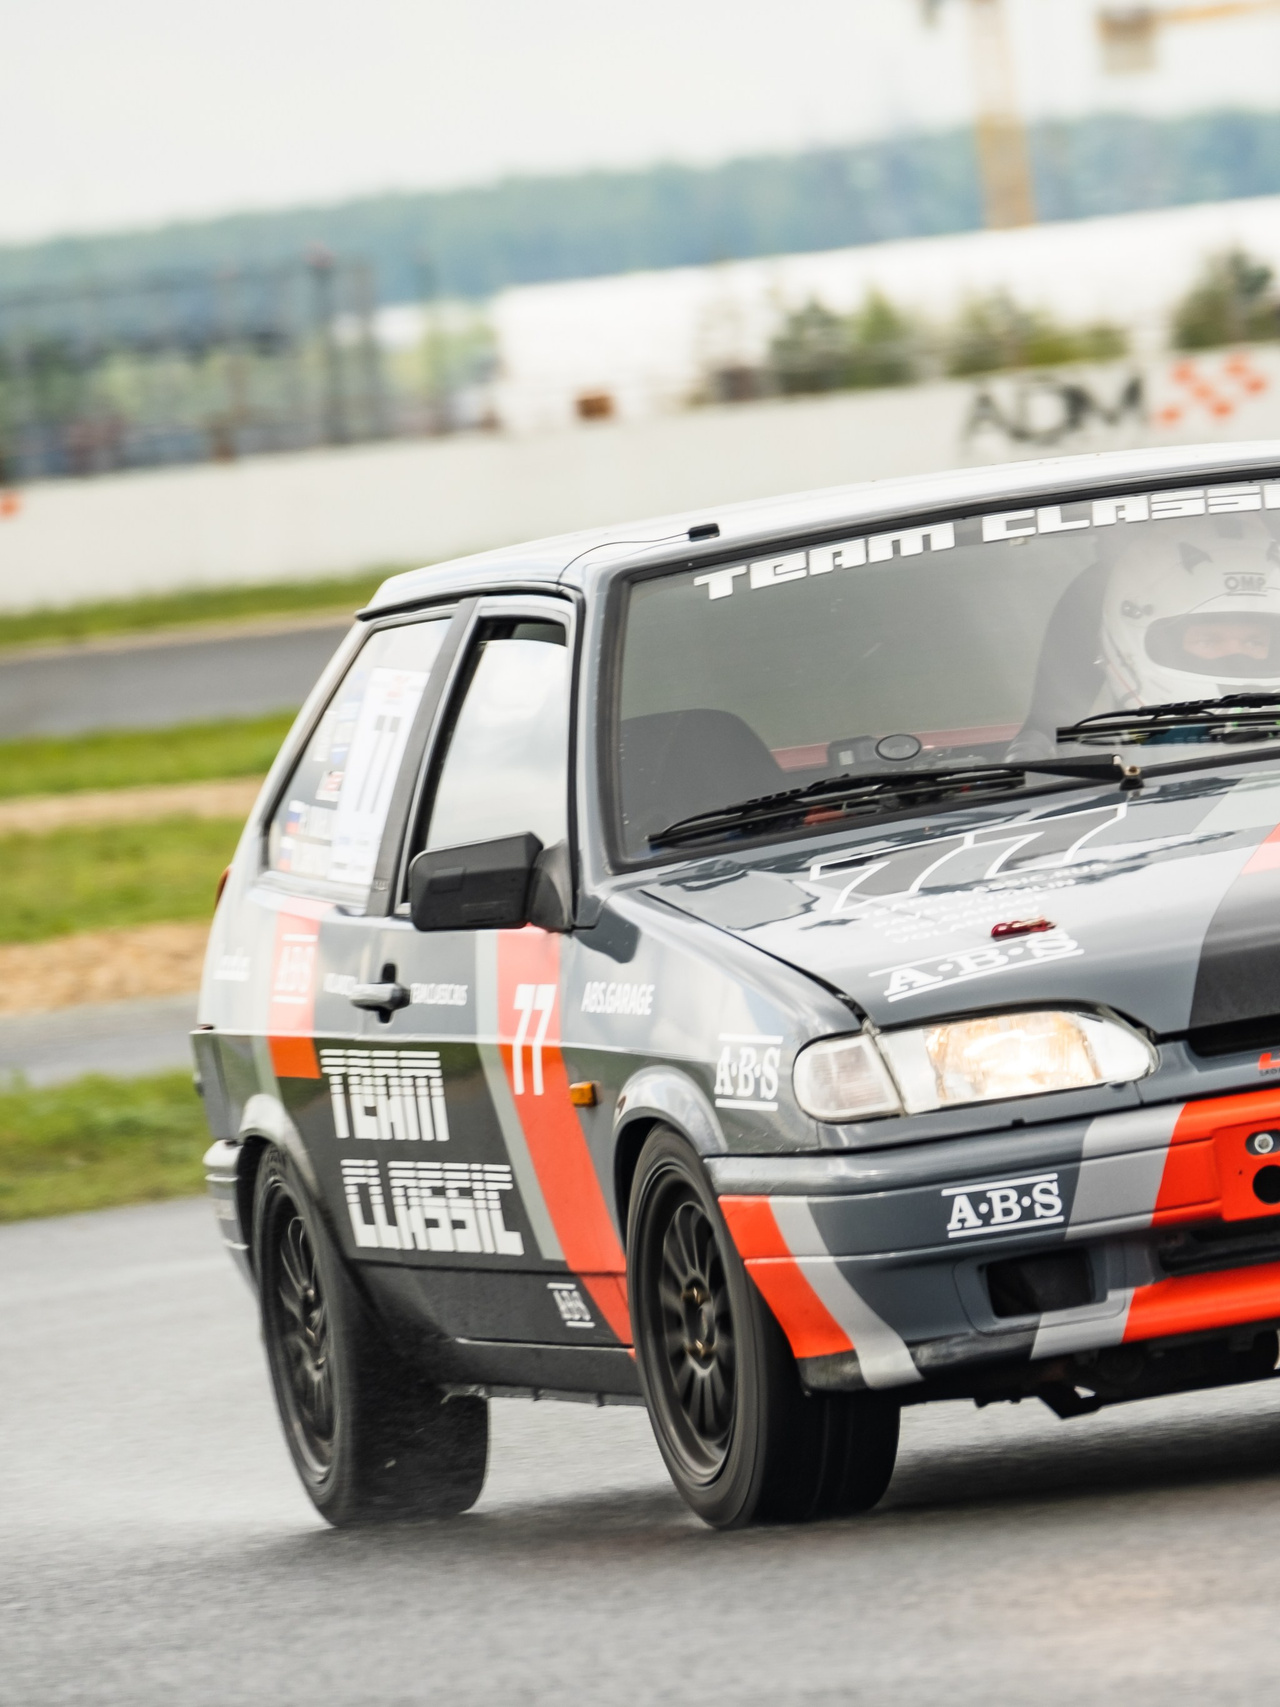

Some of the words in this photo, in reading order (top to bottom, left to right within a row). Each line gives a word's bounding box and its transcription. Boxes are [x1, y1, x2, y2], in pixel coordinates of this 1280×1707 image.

[961, 374, 1146, 450] ADM
[694, 523, 955, 600] TEAM
[1224, 575, 1267, 592] OMP
[512, 983, 557, 1096] 77
[320, 1048, 449, 1141] TEAM
[340, 1159, 524, 1256] CLASSIC
